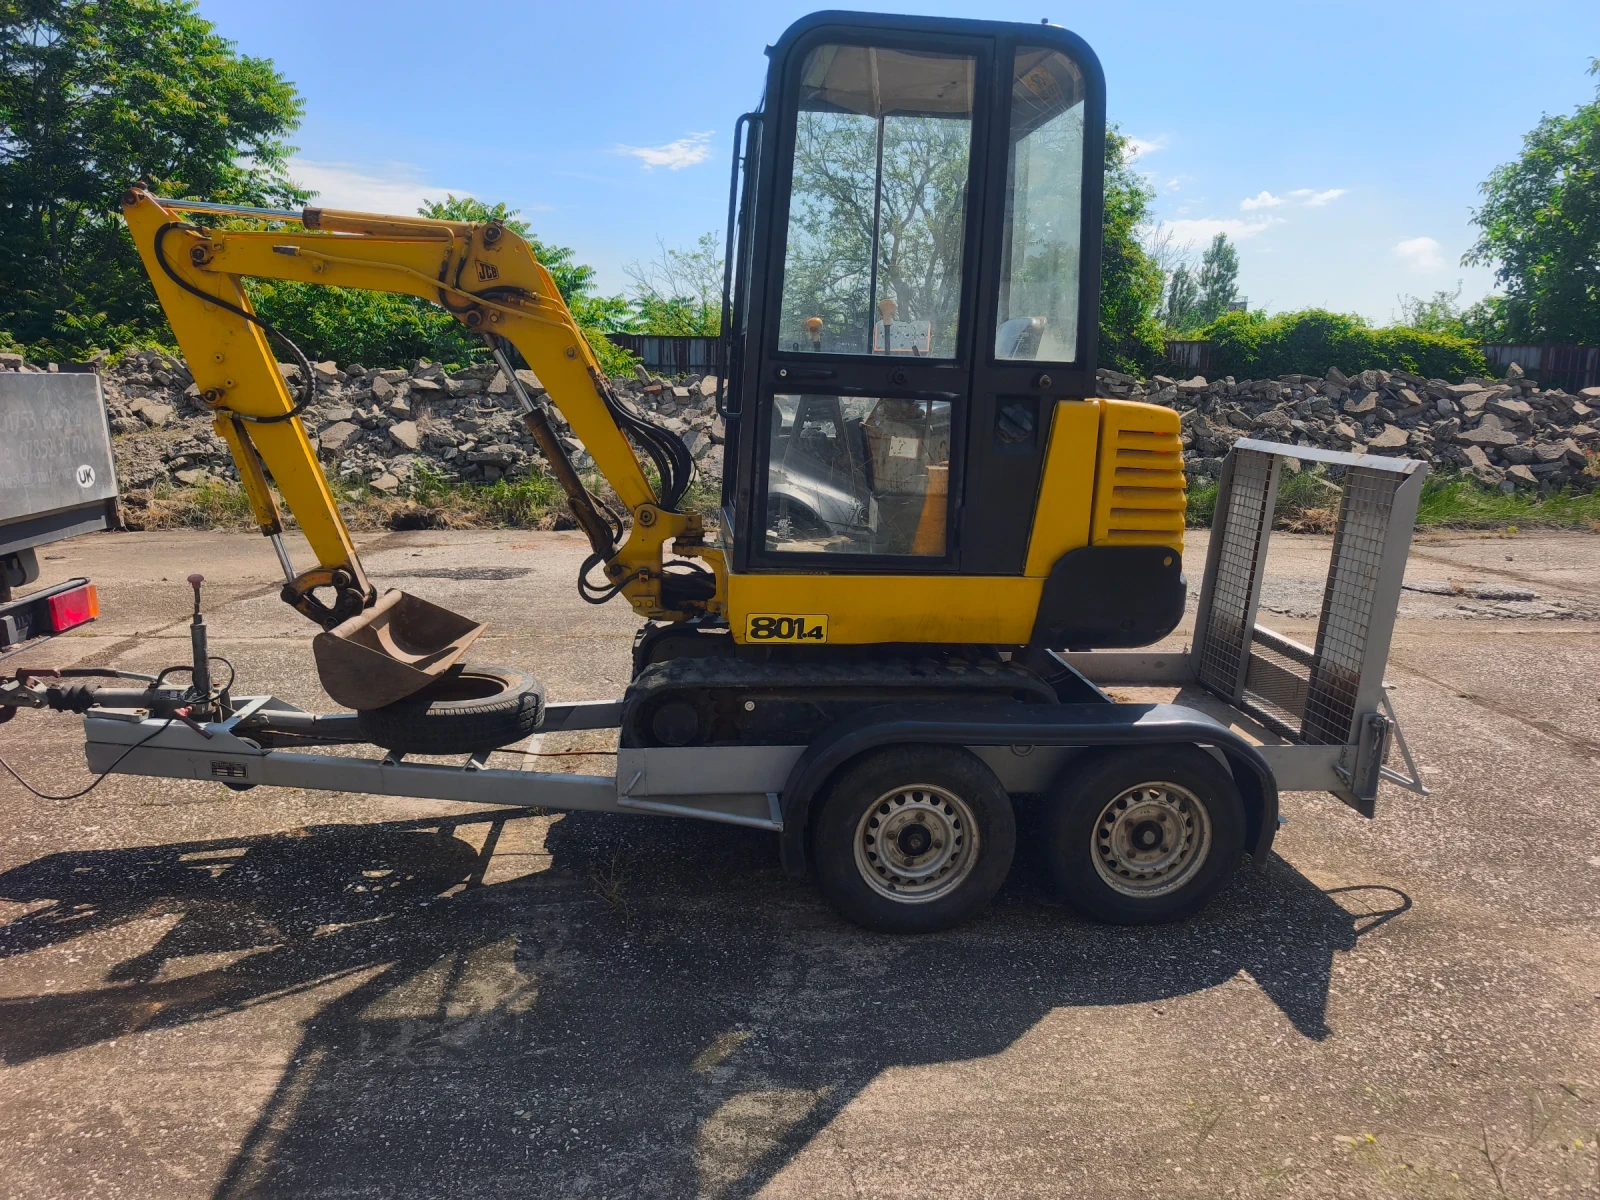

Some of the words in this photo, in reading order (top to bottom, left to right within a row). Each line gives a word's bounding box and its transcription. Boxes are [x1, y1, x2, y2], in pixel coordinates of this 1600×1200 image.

[479, 262, 498, 280] JCB
[78, 467, 94, 485] UK
[750, 616, 824, 640] 801.4
